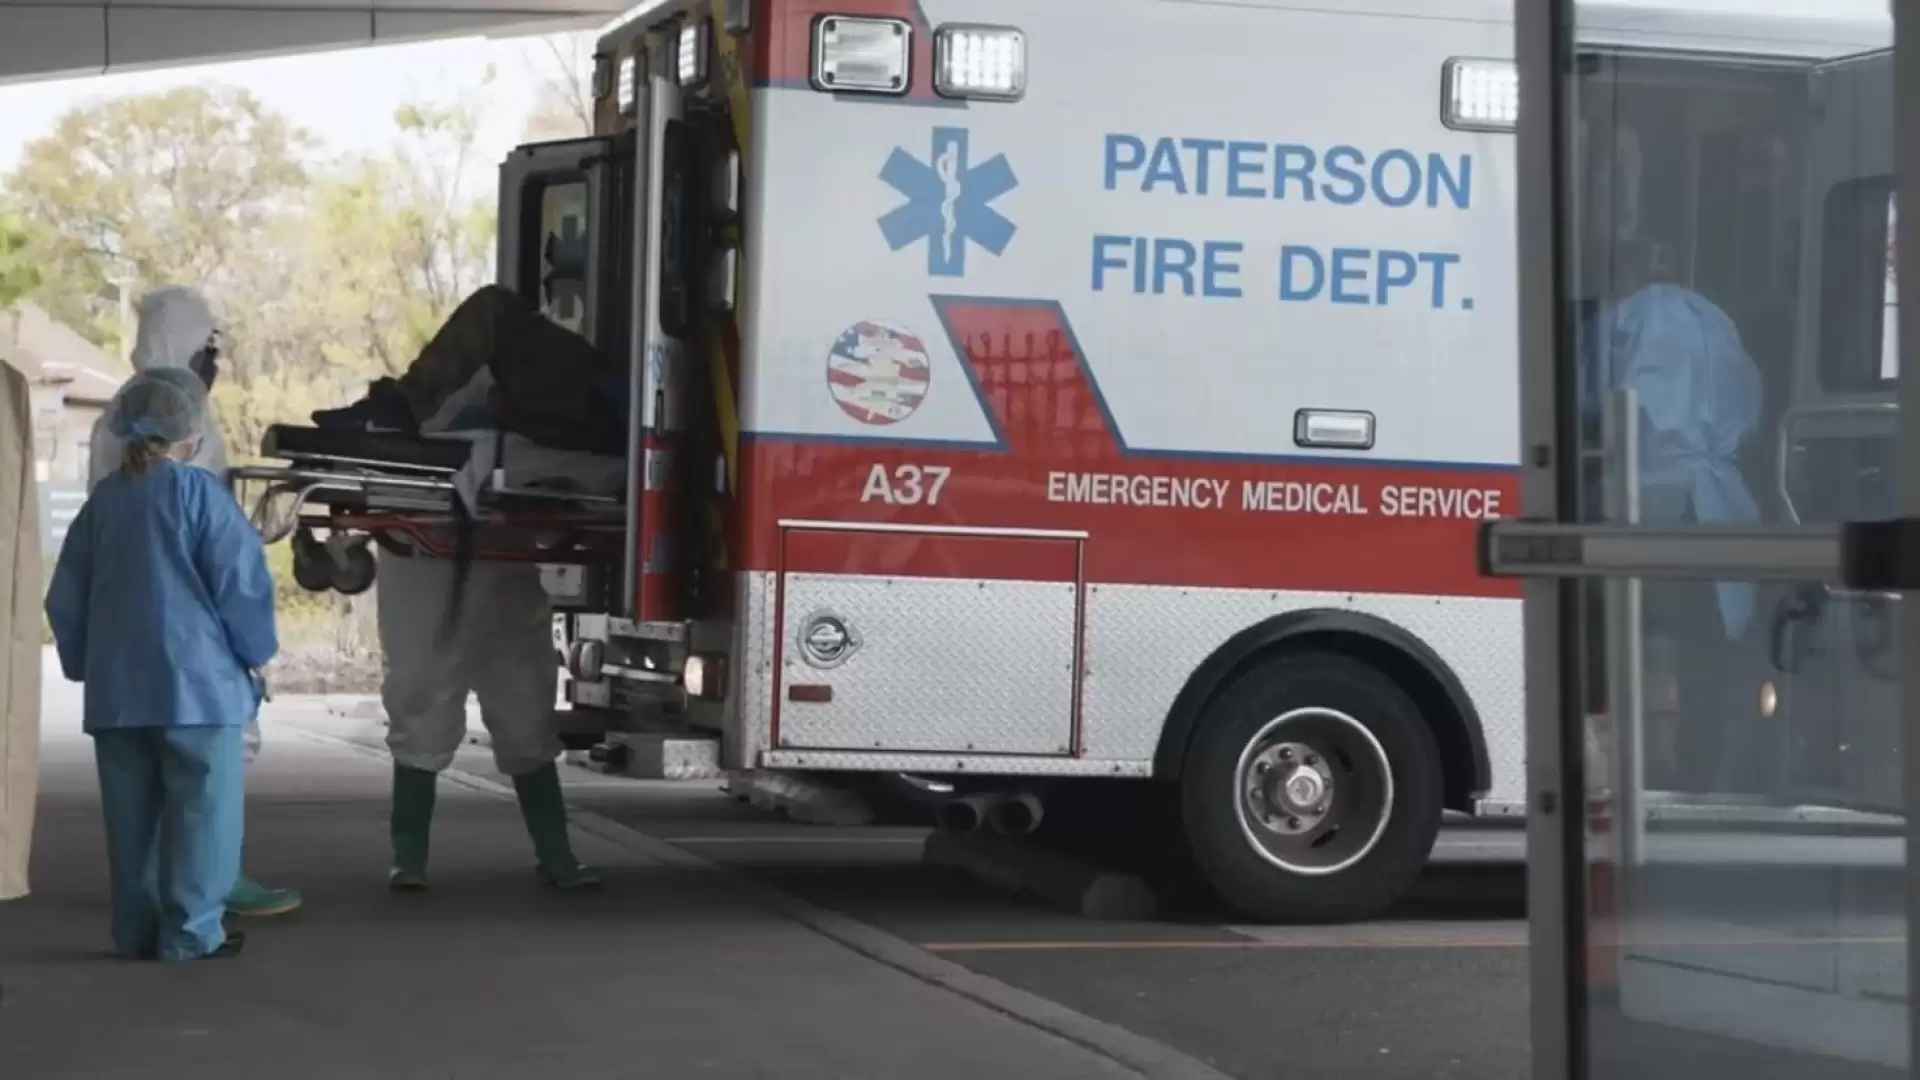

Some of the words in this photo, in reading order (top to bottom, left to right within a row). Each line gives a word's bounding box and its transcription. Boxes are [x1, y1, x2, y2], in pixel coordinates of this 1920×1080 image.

[1104, 133, 1471, 209] PATERSON
[1091, 234, 1243, 298] FIRE
[1278, 244, 1474, 310] DEPT.
[860, 463, 951, 505] A37
[1048, 471, 1230, 509] EMERGENCY
[1242, 480, 1368, 514] MEDICAL
[1380, 485, 1501, 518] SERVICE
